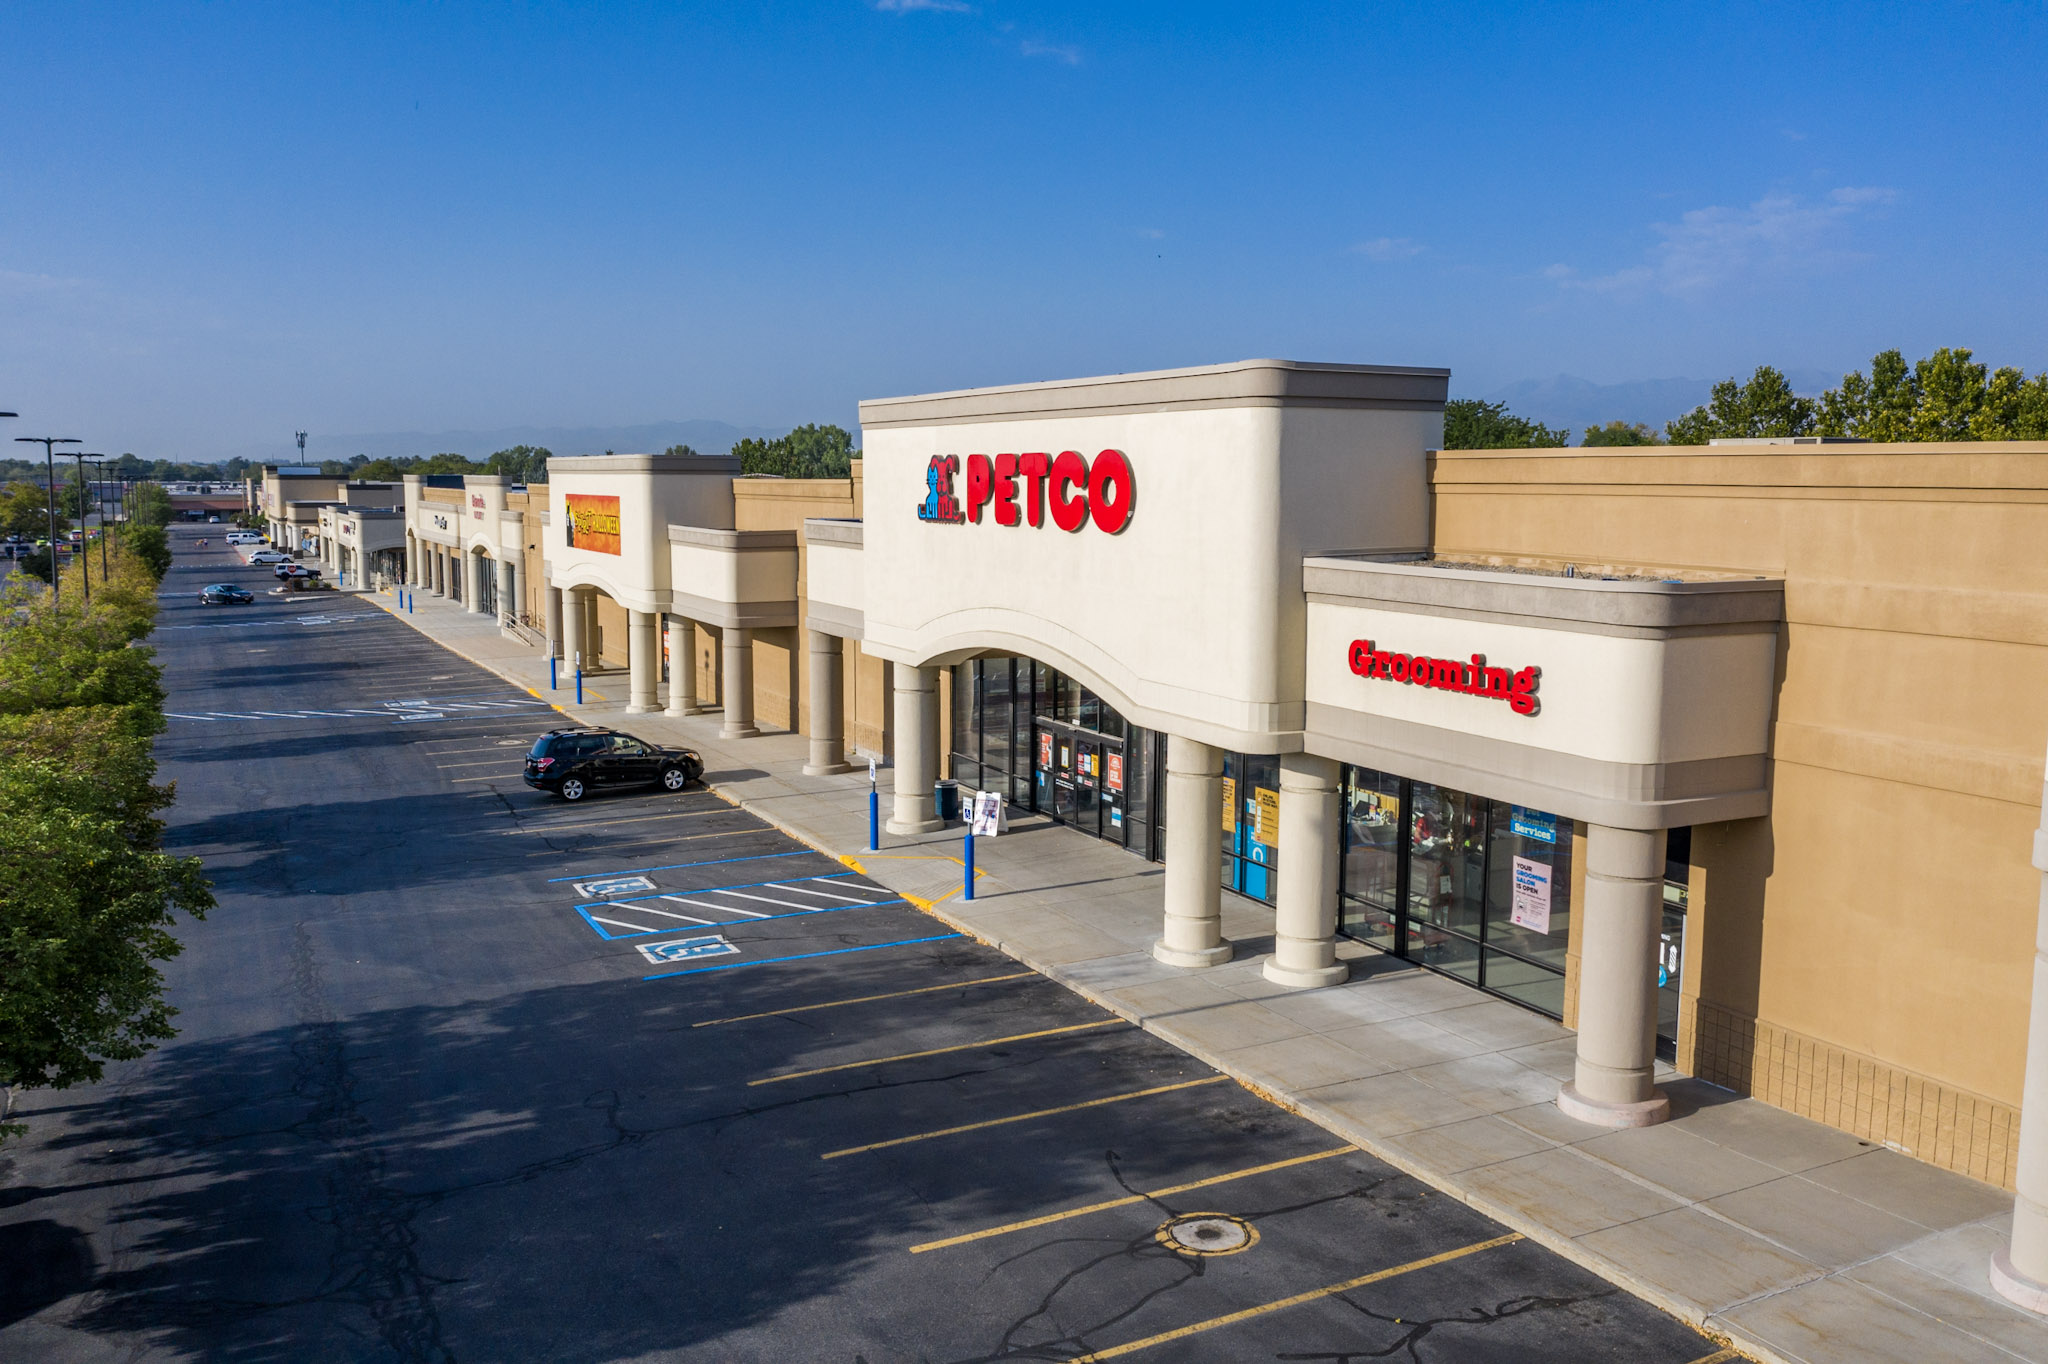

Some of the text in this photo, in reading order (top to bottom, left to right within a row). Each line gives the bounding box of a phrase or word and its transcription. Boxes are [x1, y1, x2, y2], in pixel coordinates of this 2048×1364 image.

[967, 449, 1136, 535] PETCO
[1348, 639, 1541, 716] Grooming
[1514, 822, 1552, 841] Services
[1516, 862, 1533, 872] YOUR
[1516, 869, 1548, 884] GROOMING
[1516, 876, 1536, 887] SALON
[1522, 885, 1539, 895] OPEN
